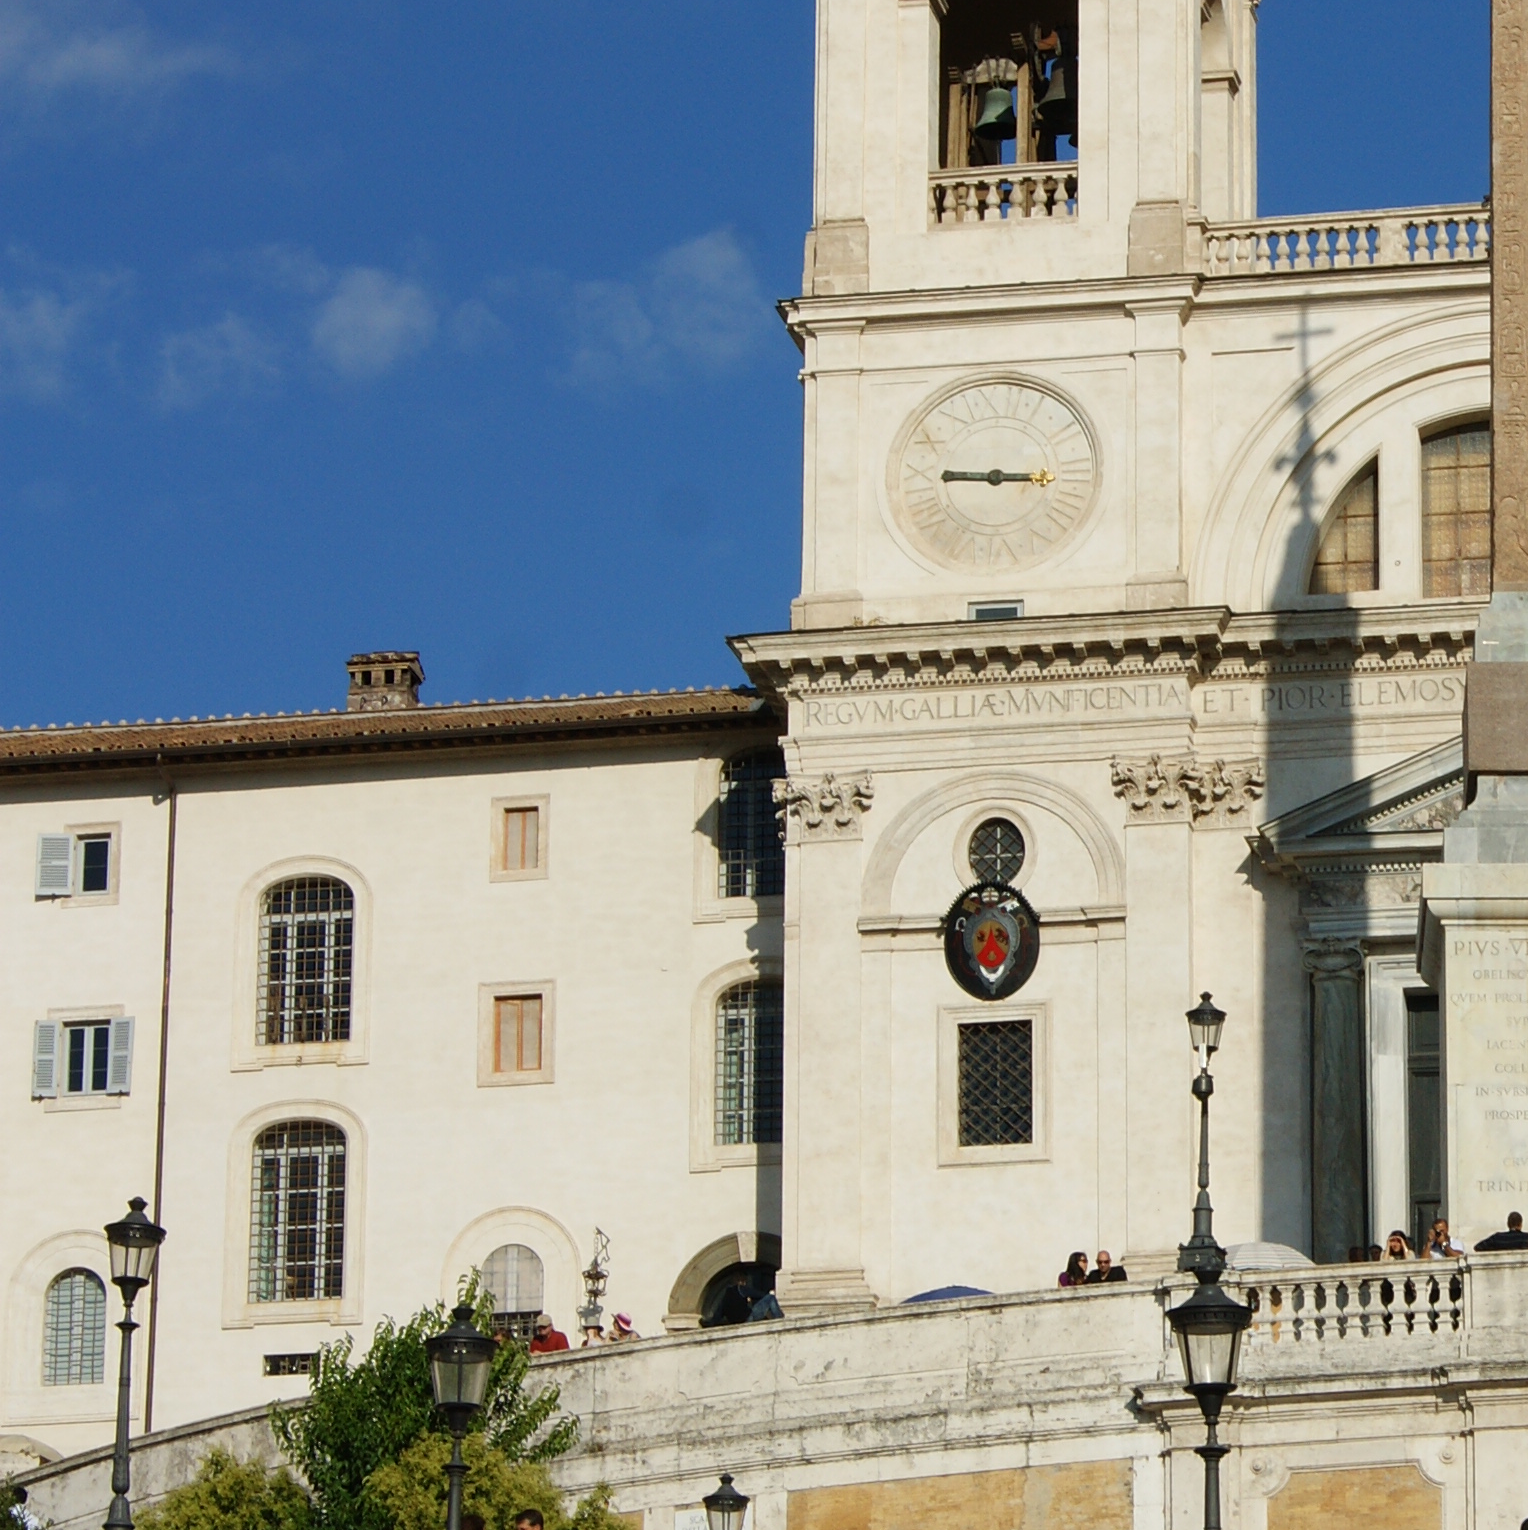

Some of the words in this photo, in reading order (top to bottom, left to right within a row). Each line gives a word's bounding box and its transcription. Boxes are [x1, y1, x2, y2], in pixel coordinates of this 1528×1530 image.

[805, 699, 894, 727] REGVM
[1007, 683, 1182, 715] MVNIFICENTIA
[1203, 688, 1243, 713] ET
[1261, 685, 1329, 711] PIOR
[1454, 940, 1500, 956] PIVS
[1450, 993, 1487, 1006] QVEM
[1475, 1086, 1489, 1097] IN
